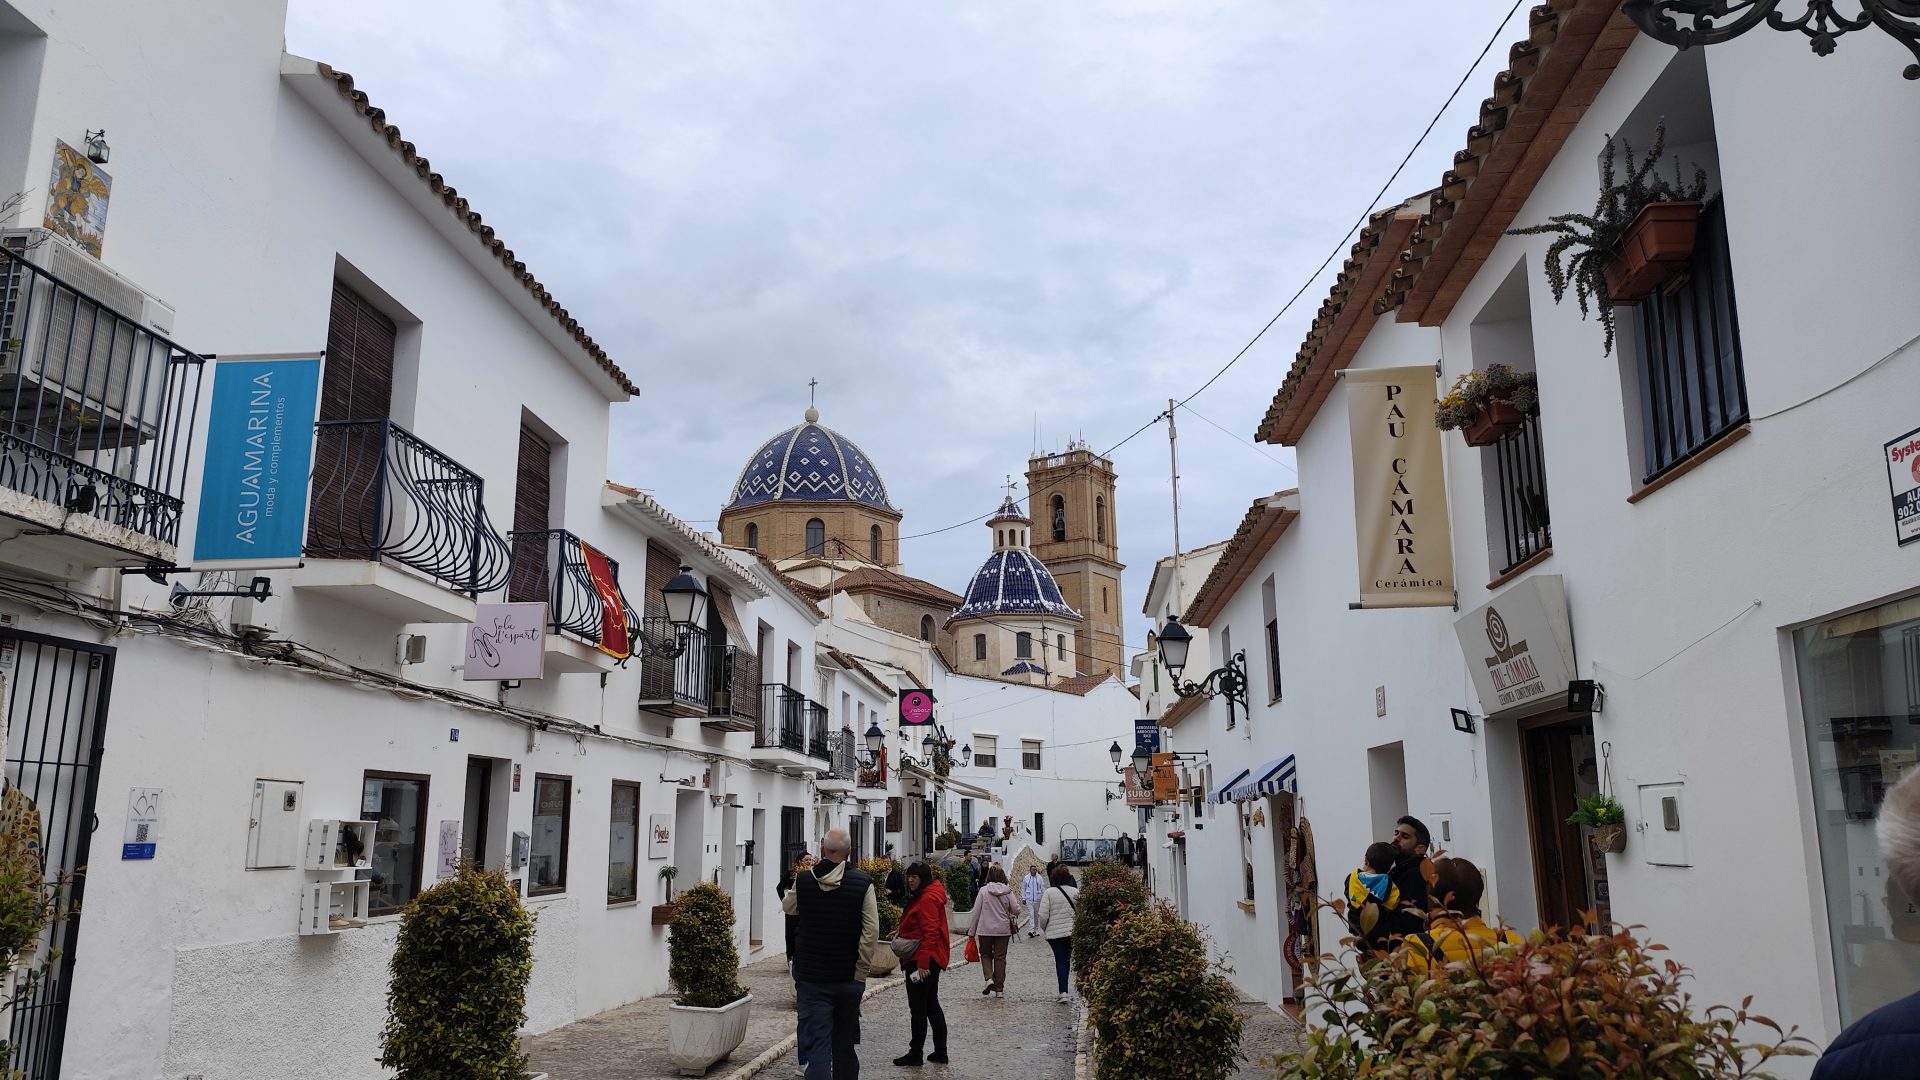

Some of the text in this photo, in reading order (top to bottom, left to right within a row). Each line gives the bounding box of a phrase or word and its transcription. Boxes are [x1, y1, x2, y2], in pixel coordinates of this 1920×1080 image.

[270, 396, 285, 474] complementos
[236, 371, 273, 545] AGUAMARINA
[1385, 384, 1418, 575] PAU CÁMARA
[265, 487, 277, 518] moda
[1897, 503, 1914, 519] 902
[1375, 578, 1443, 589] Cerámica
[1127, 790, 1151, 798] SURO
